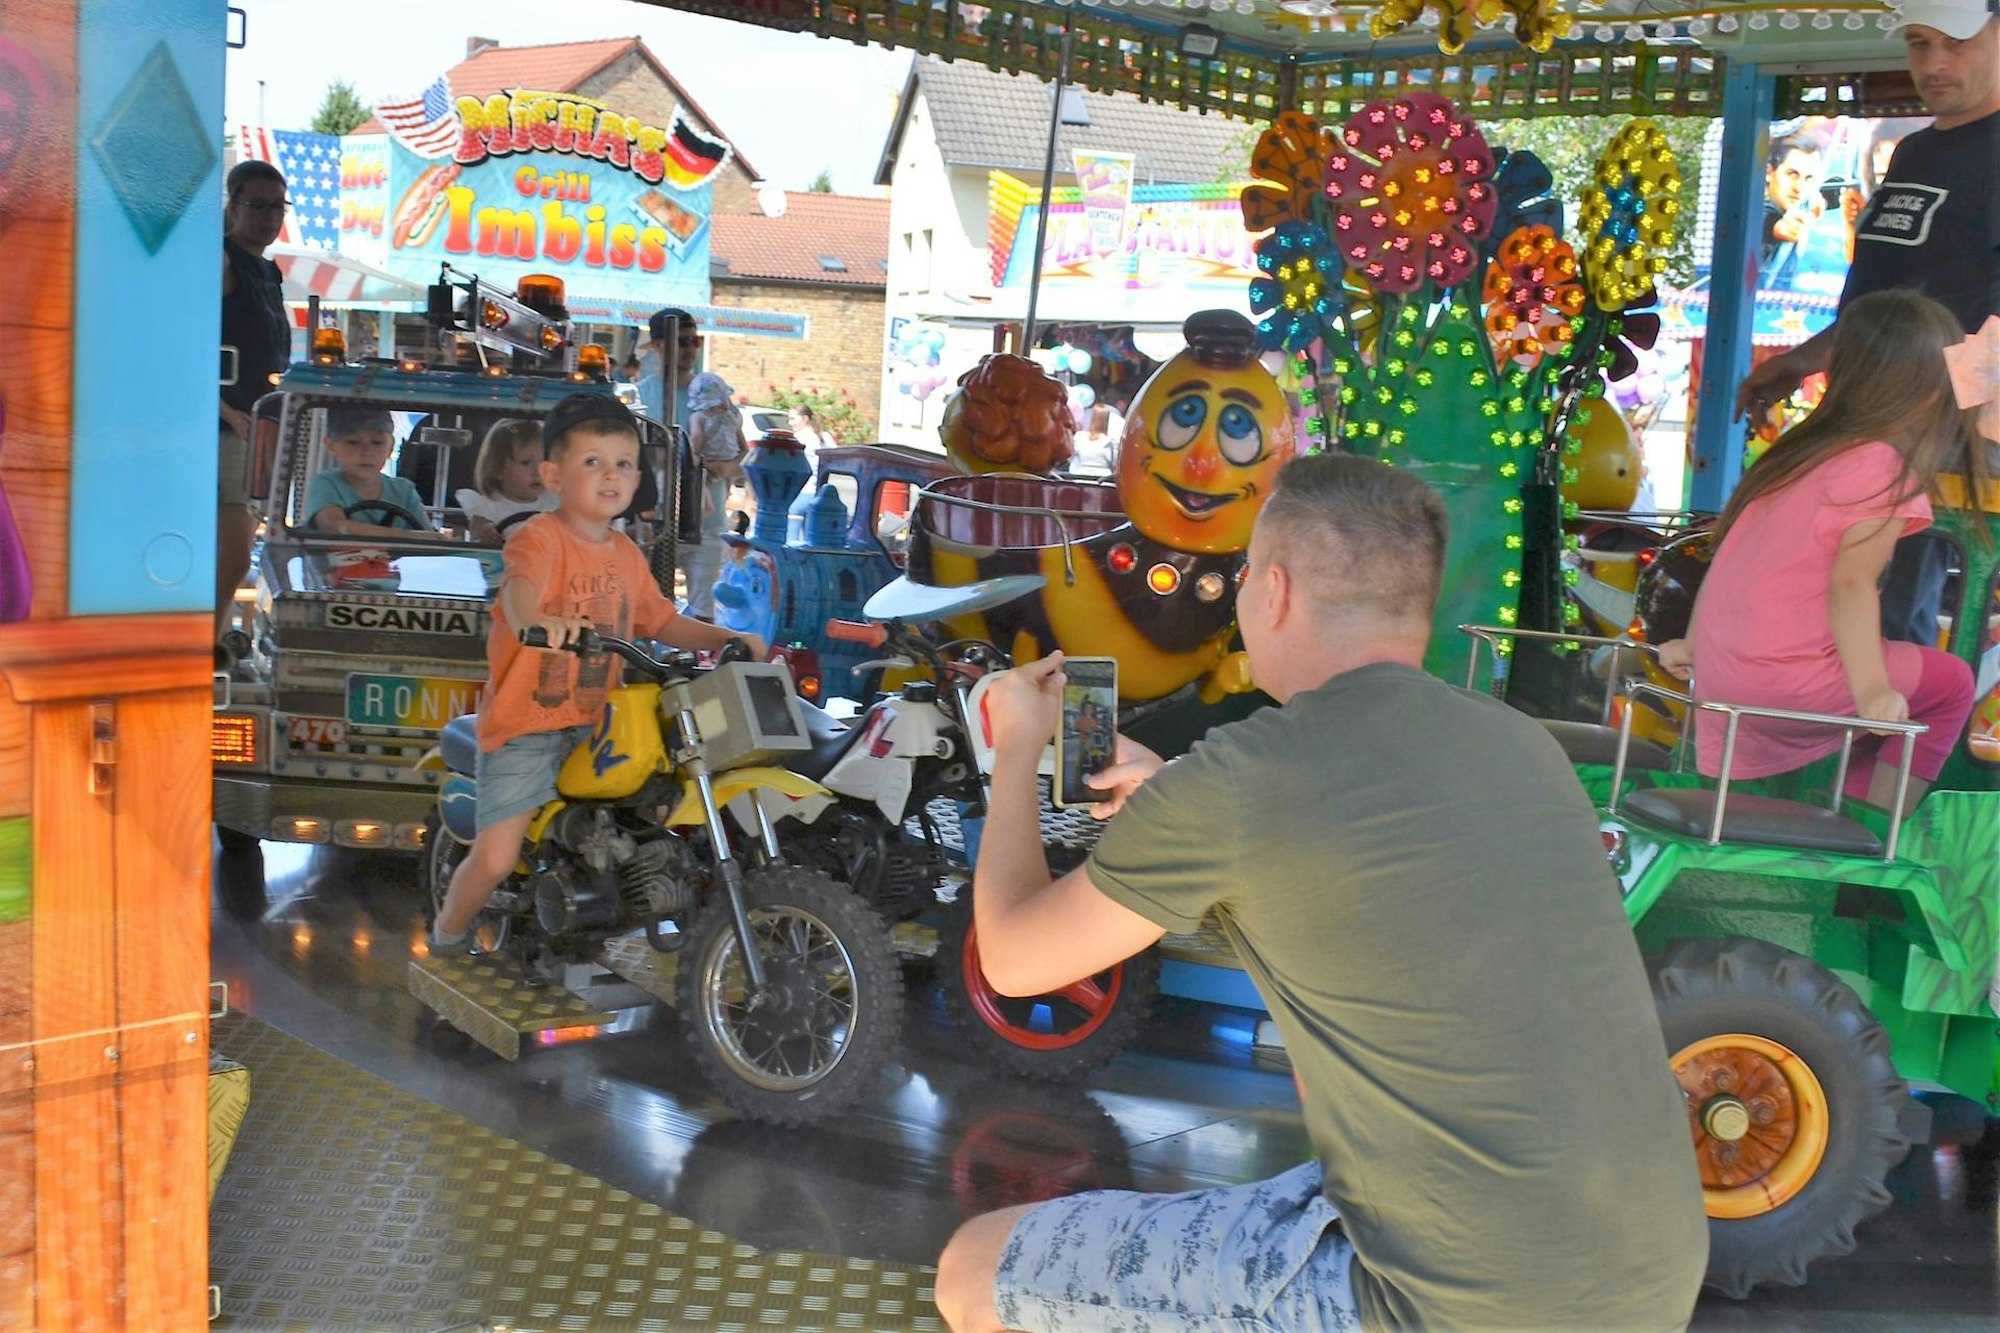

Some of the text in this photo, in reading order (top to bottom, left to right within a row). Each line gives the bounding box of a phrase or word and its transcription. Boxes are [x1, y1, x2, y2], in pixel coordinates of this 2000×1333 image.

[514, 166, 591, 202] Grill
[341, 199, 385, 237] Dog
[443, 186, 667, 272] Imbiss
[1873, 212, 1914, 231] JONES
[329, 605, 471, 635] SCANIA
[291, 720, 346, 744] 470
